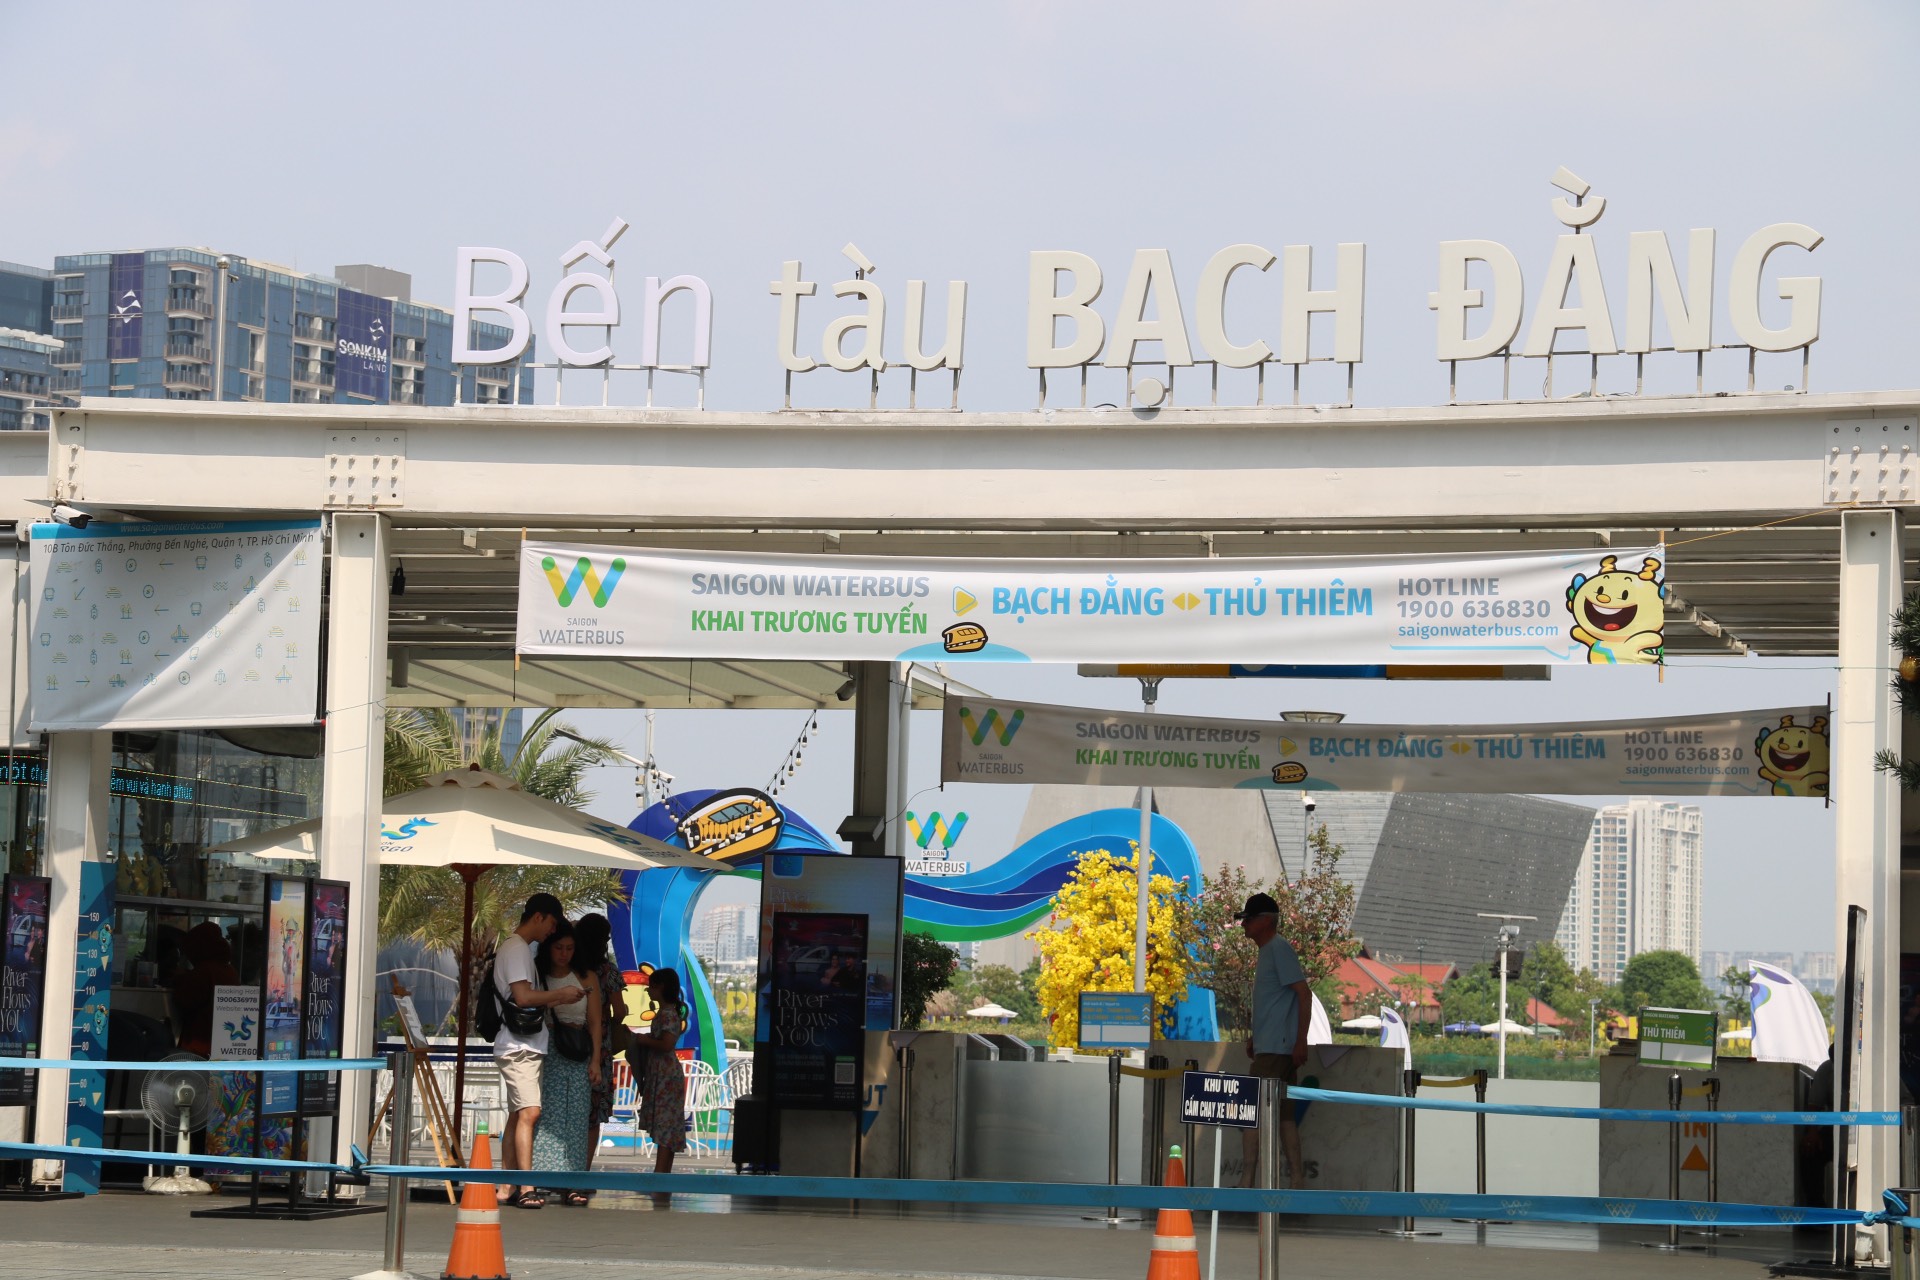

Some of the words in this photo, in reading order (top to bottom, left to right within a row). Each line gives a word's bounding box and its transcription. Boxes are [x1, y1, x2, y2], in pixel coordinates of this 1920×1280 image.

[451, 216, 714, 370] Bến
[770, 242, 968, 373] tàu
[1027, 243, 1367, 407] BẠCH
[1428, 165, 1826, 363] ĐẰNG
[339, 339, 387, 363] SONKIM
[363, 361, 387, 373] LAND
[120, 522, 224, 534] www.saigonwaterbus.com
[43, 543, 59, 554] 10B
[60, 542, 76, 553] Tôn
[78, 542, 95, 553] Đức
[128, 540, 162, 552] Phường
[164, 537, 181, 550] Bến
[211, 536, 235, 550] Quận
[247, 536, 259, 546] TP.
[261, 533, 274, 546] Hồ
[275, 533, 290, 545] Chí
[292, 533, 314, 543] Minh
[691, 573, 786, 596] SAIGON
[795, 576, 930, 598] WATERBUS
[1398, 577, 1500, 596] HOTLINE
[992, 586, 1071, 624] BẠCH
[1079, 573, 1165, 617] ĐẰNG
[1204, 577, 1266, 617] THỦ
[1275, 578, 1373, 617] THIÊM
[1397, 600, 1454, 618] 1900
[1462, 600, 1551, 618] 636830
[566, 617, 598, 627] SAIGON
[691, 609, 744, 632] KHAI
[751, 609, 849, 634] TRƯƠNG
[853, 602, 928, 634] TUYẾN
[539, 629, 625, 645] WATERBUS
[1398, 622, 1559, 640] saigonwaterbus.com
[1076, 722, 1148, 740] SAIGON
[1154, 724, 1261, 743] WATERBUS
[1624, 730, 1704, 745] HOTLINE
[1309, 736, 1371, 763] BẠCH
[1377, 731, 1443, 758] ĐẰNG
[1474, 733, 1524, 759] THỦ
[1530, 732, 1606, 759] THIÊM
[1624, 746, 1670, 762] 1900
[1675, 746, 1744, 762] 636830
[978, 753, 1003, 761] SAIGON
[1076, 748, 1117, 766] KHAI
[1123, 748, 1198, 769] TRƯƠNG
[1203, 746, 1261, 770] TUYẾN
[957, 761, 1024, 775] WATERBUS
[1625, 763, 1750, 777] saigonwaterbus.com
[173, 782, 194, 801] phúc
[905, 861, 965, 873] WATERBUS
[89, 913, 99, 922] 150
[88, 949, 98, 959] 130
[86, 967, 97, 977] 120
[85, 986, 96, 996] 110
[217, 988, 243, 996] Booking
[776, 988, 830, 1010] River
[780, 1007, 839, 1028] Flows
[82, 1023, 90, 1033] 90
[1642, 1023, 1660, 1038] THỦ
[1661, 1026, 1686, 1040] THIÊM
[81, 1041, 89, 1051] 80
[220, 1047, 257, 1056] WATERGO
[79, 1079, 88, 1089] 60
[1204, 1078, 1222, 1093] KHU
[1223, 1079, 1240, 1097] VỰC
[78, 1097, 87, 1107] 50
[1184, 1094, 1200, 1117] CẤM
[1200, 1100, 1217, 1121] CHẠY
[1216, 1102, 1226, 1119] XE
[1226, 1100, 1239, 1120] VÀO
[1238, 1099, 1257, 1122] SẢNH
